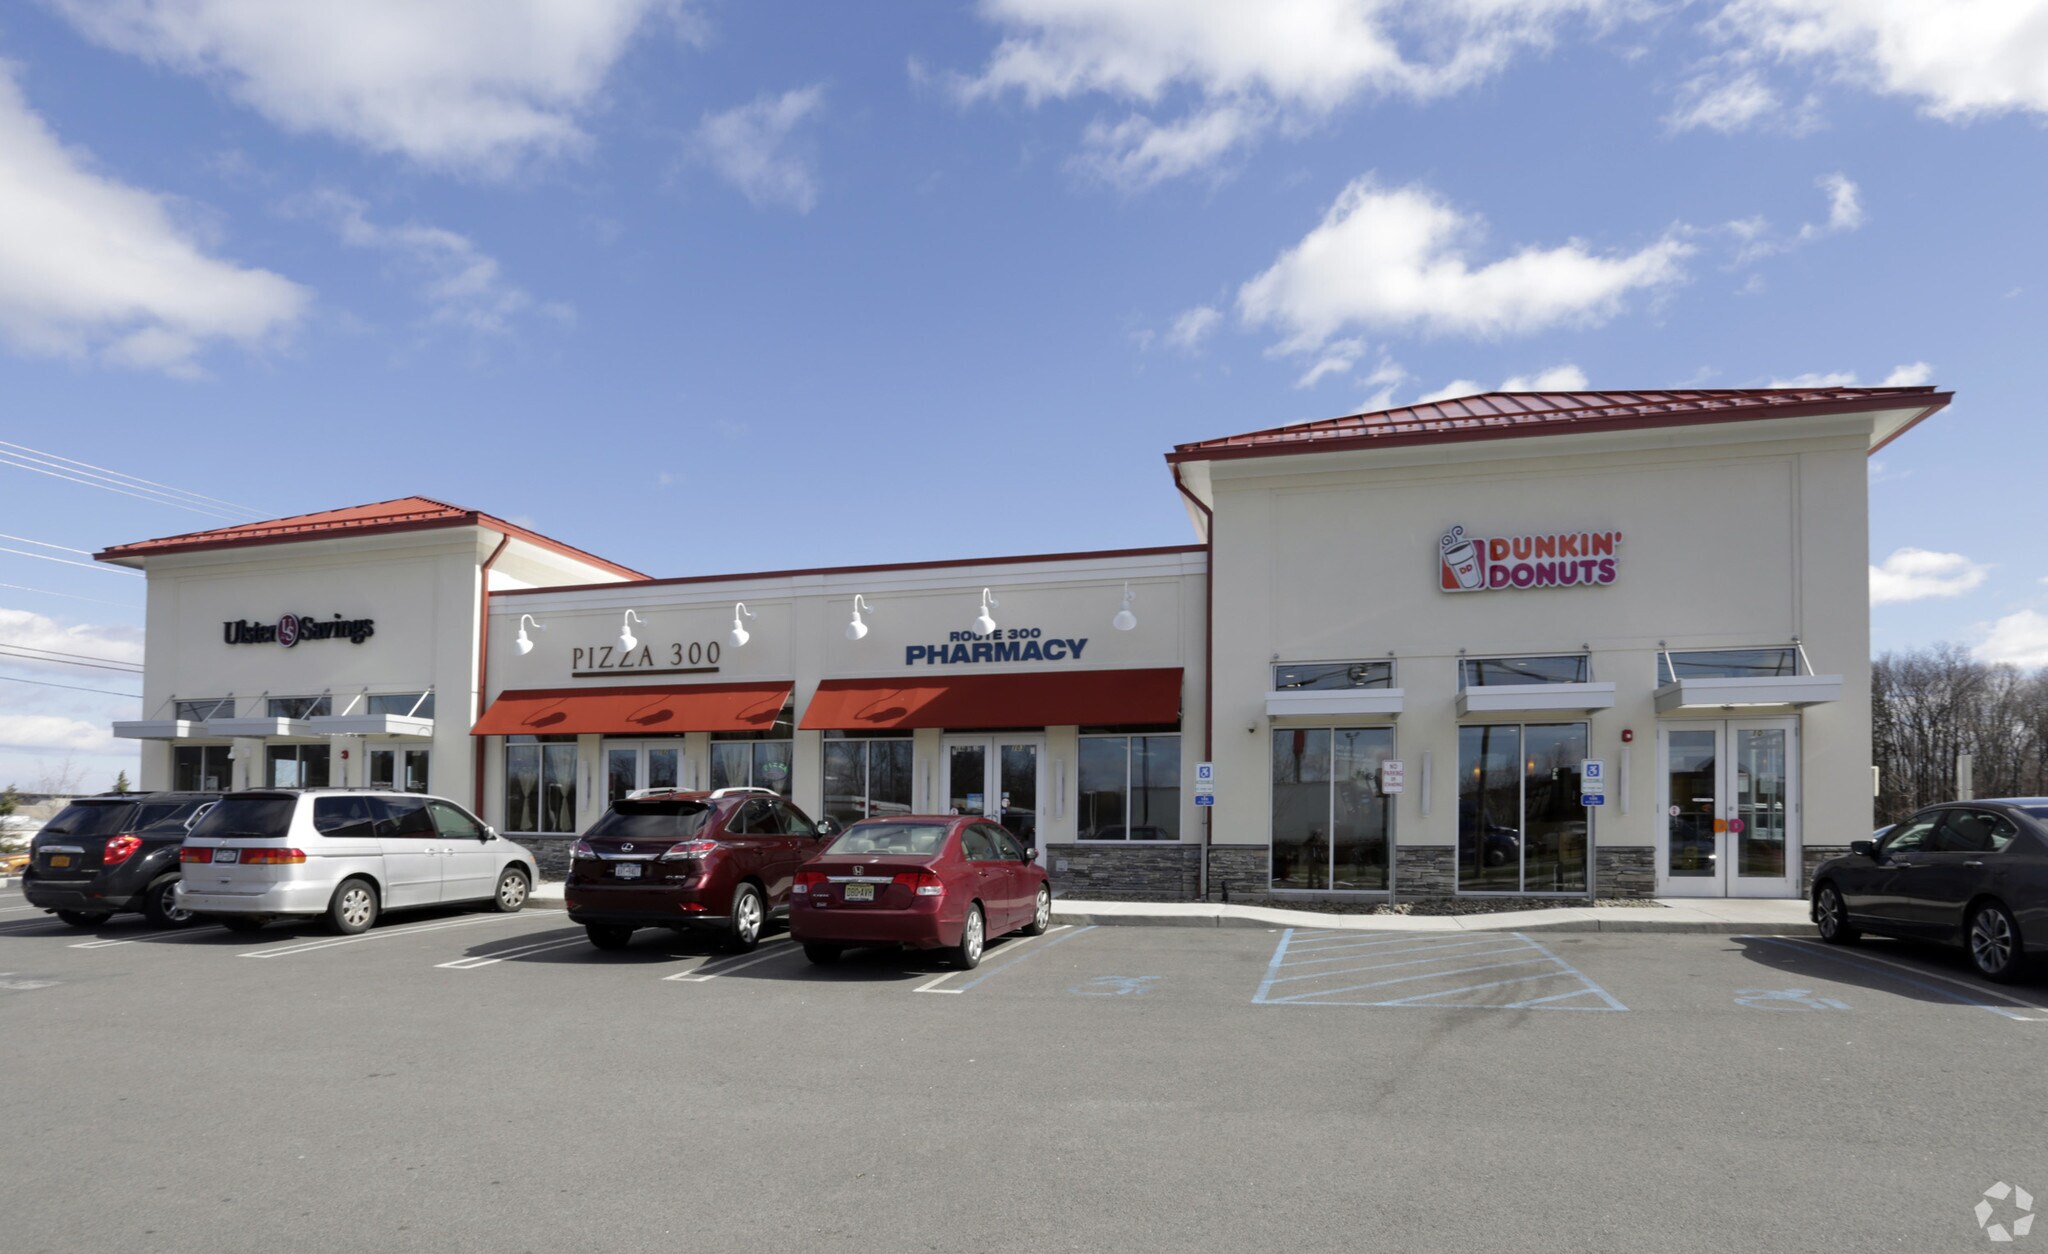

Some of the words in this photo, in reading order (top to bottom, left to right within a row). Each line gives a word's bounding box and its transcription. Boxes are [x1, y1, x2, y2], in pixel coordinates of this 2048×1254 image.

[1489, 531, 1622, 561] DUNKIN'
[1489, 558, 1616, 588] DONUTS
[223, 619, 277, 645] Ulster
[300, 613, 375, 645] Savings
[1007, 628, 1041, 640] 300
[572, 645, 654, 670] PIZZA
[670, 641, 721, 666] 300
[905, 638, 1089, 666] PHARMACY
